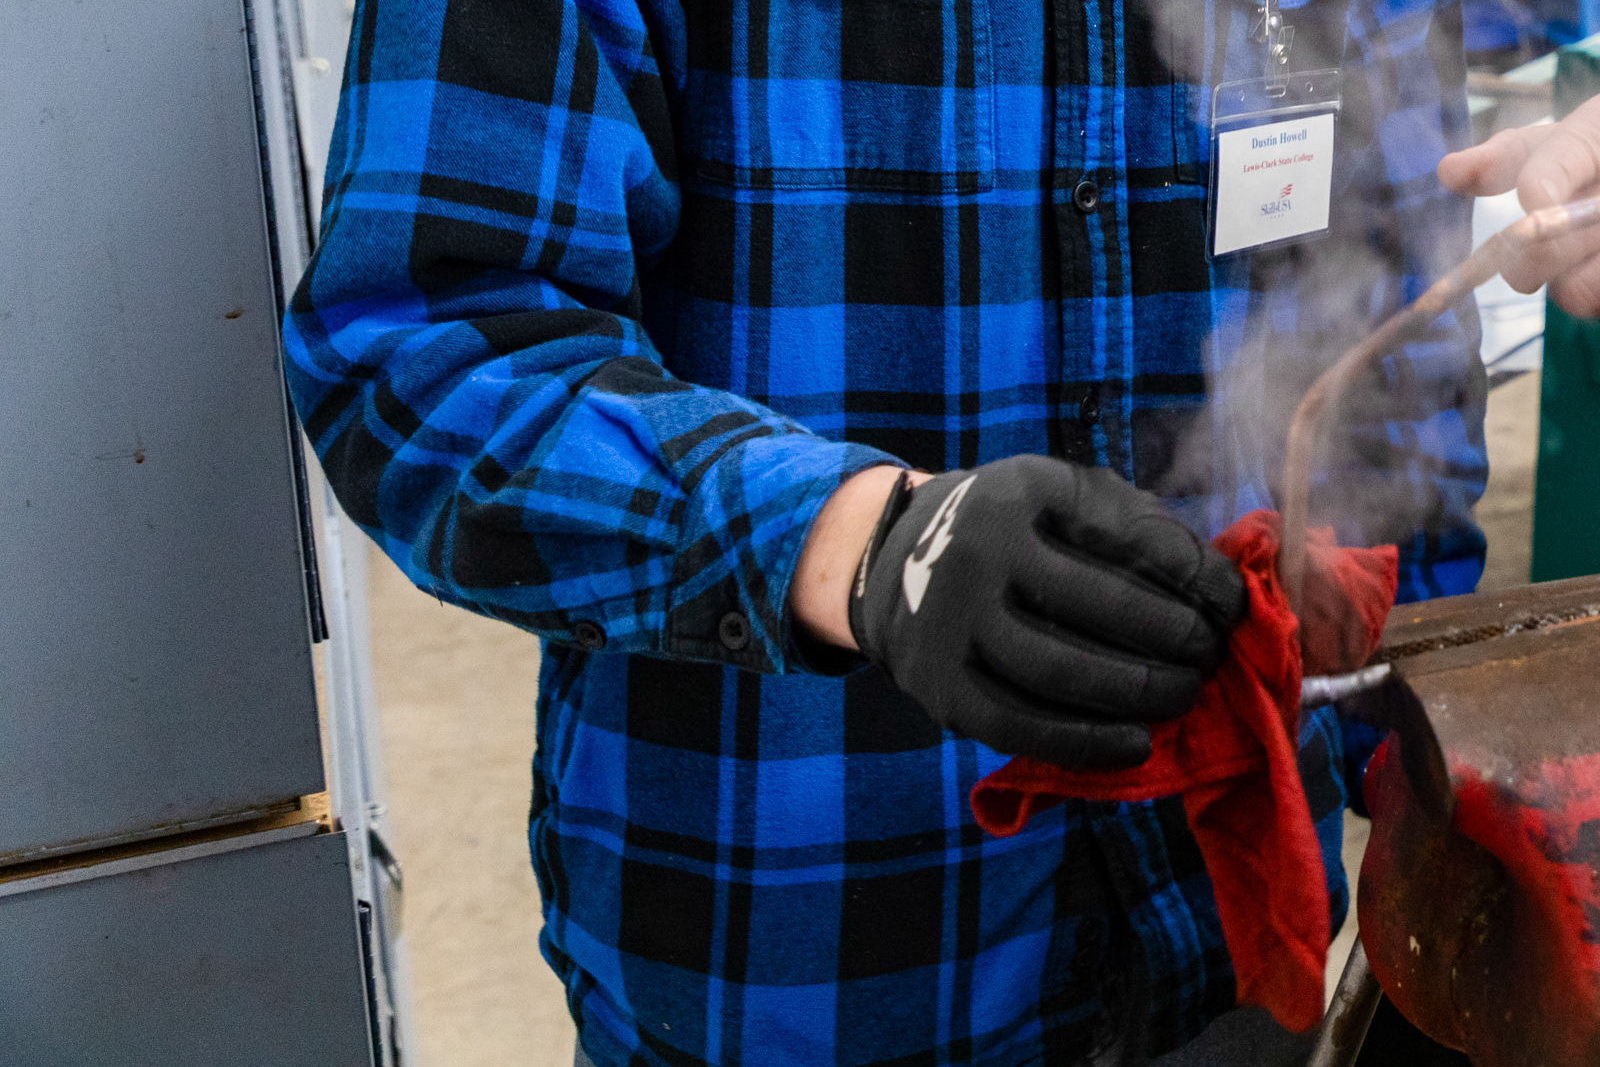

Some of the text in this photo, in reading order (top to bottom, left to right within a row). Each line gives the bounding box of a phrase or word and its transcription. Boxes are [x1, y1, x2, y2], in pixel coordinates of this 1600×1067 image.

[1252, 129, 1307, 149] Dustin Howell
[1243, 153, 1314, 173] Lewis-Clark State College
